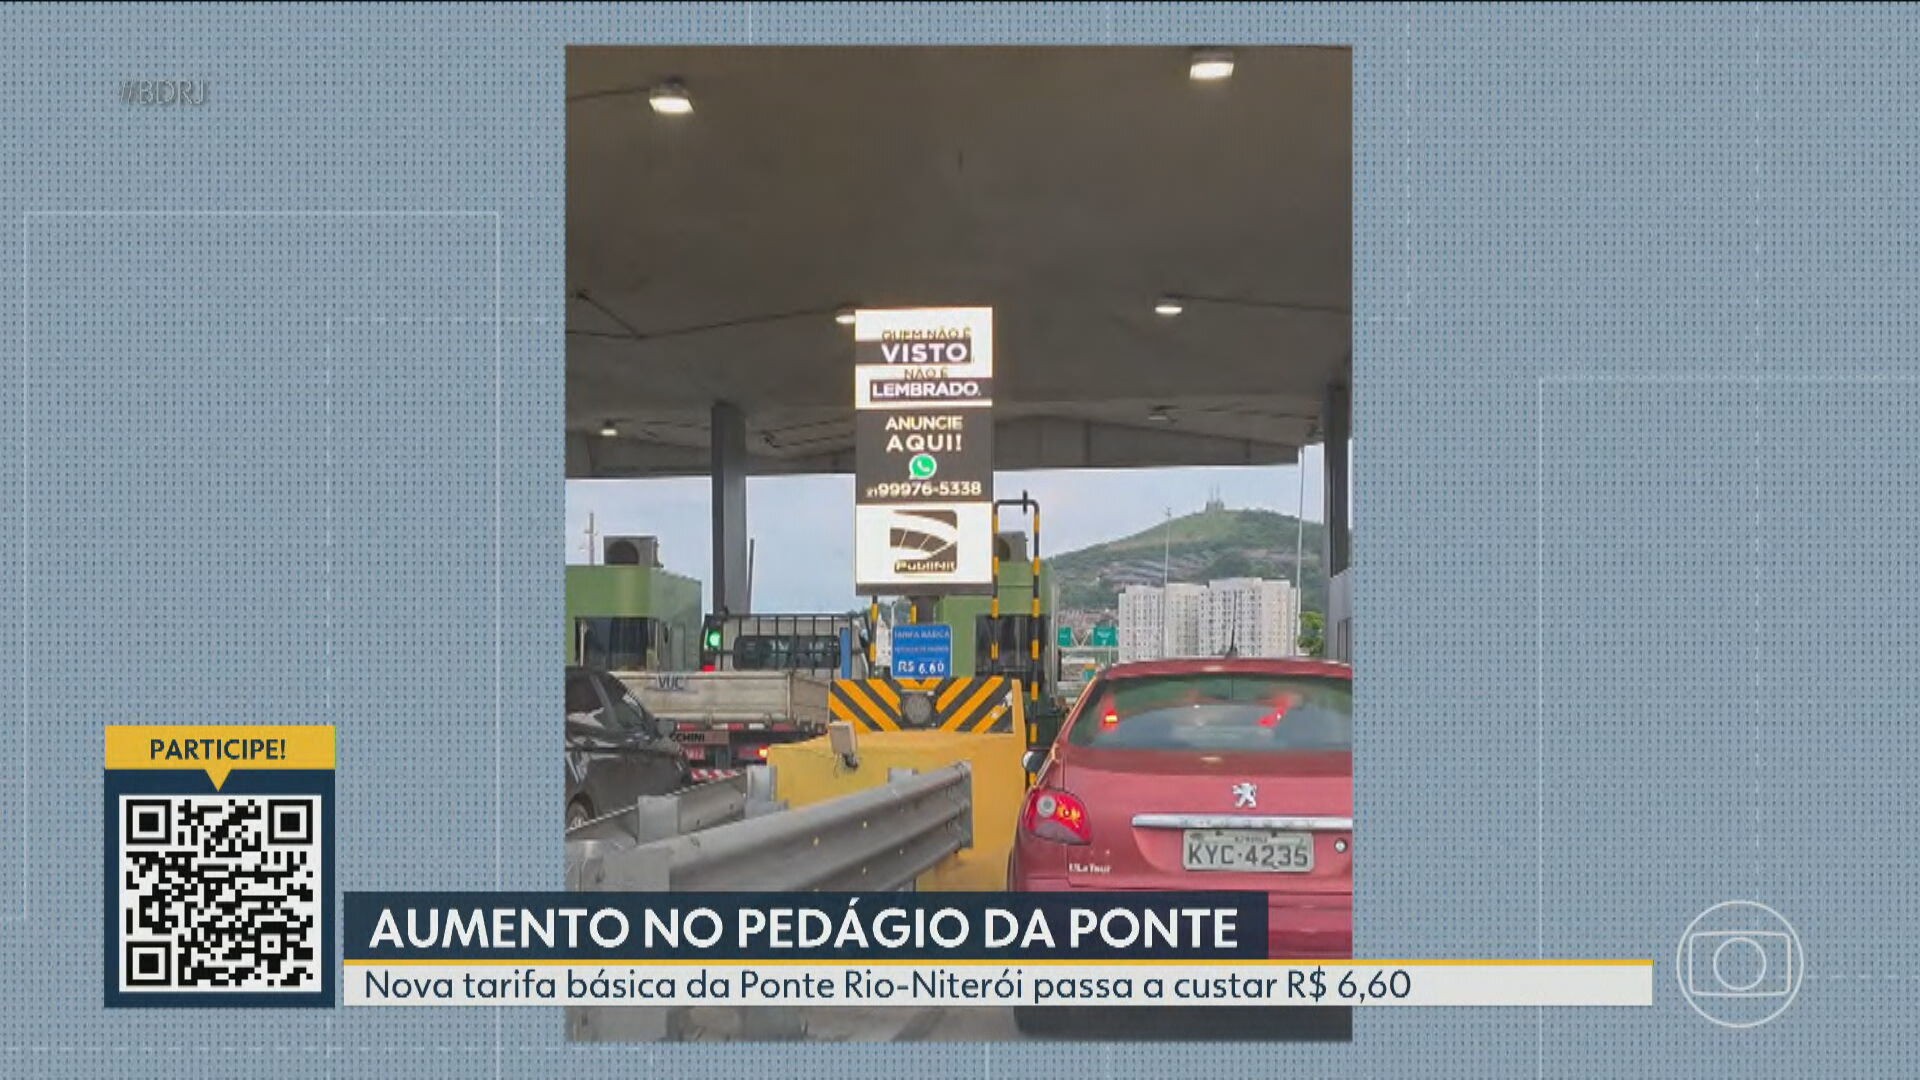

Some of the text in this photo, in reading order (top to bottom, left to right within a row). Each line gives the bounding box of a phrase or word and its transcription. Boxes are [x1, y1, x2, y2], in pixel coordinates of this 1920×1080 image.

[881, 328, 922, 340] QUEM
[926, 326, 959, 340] NÃO
[904, 368, 936, 380] NÃO
[872, 382, 982, 398] LEMBRADO.
[885, 416, 964, 431] ANUNCIE
[886, 434, 962, 453] AQUI!
[878, 481, 982, 498] 99976-5338
